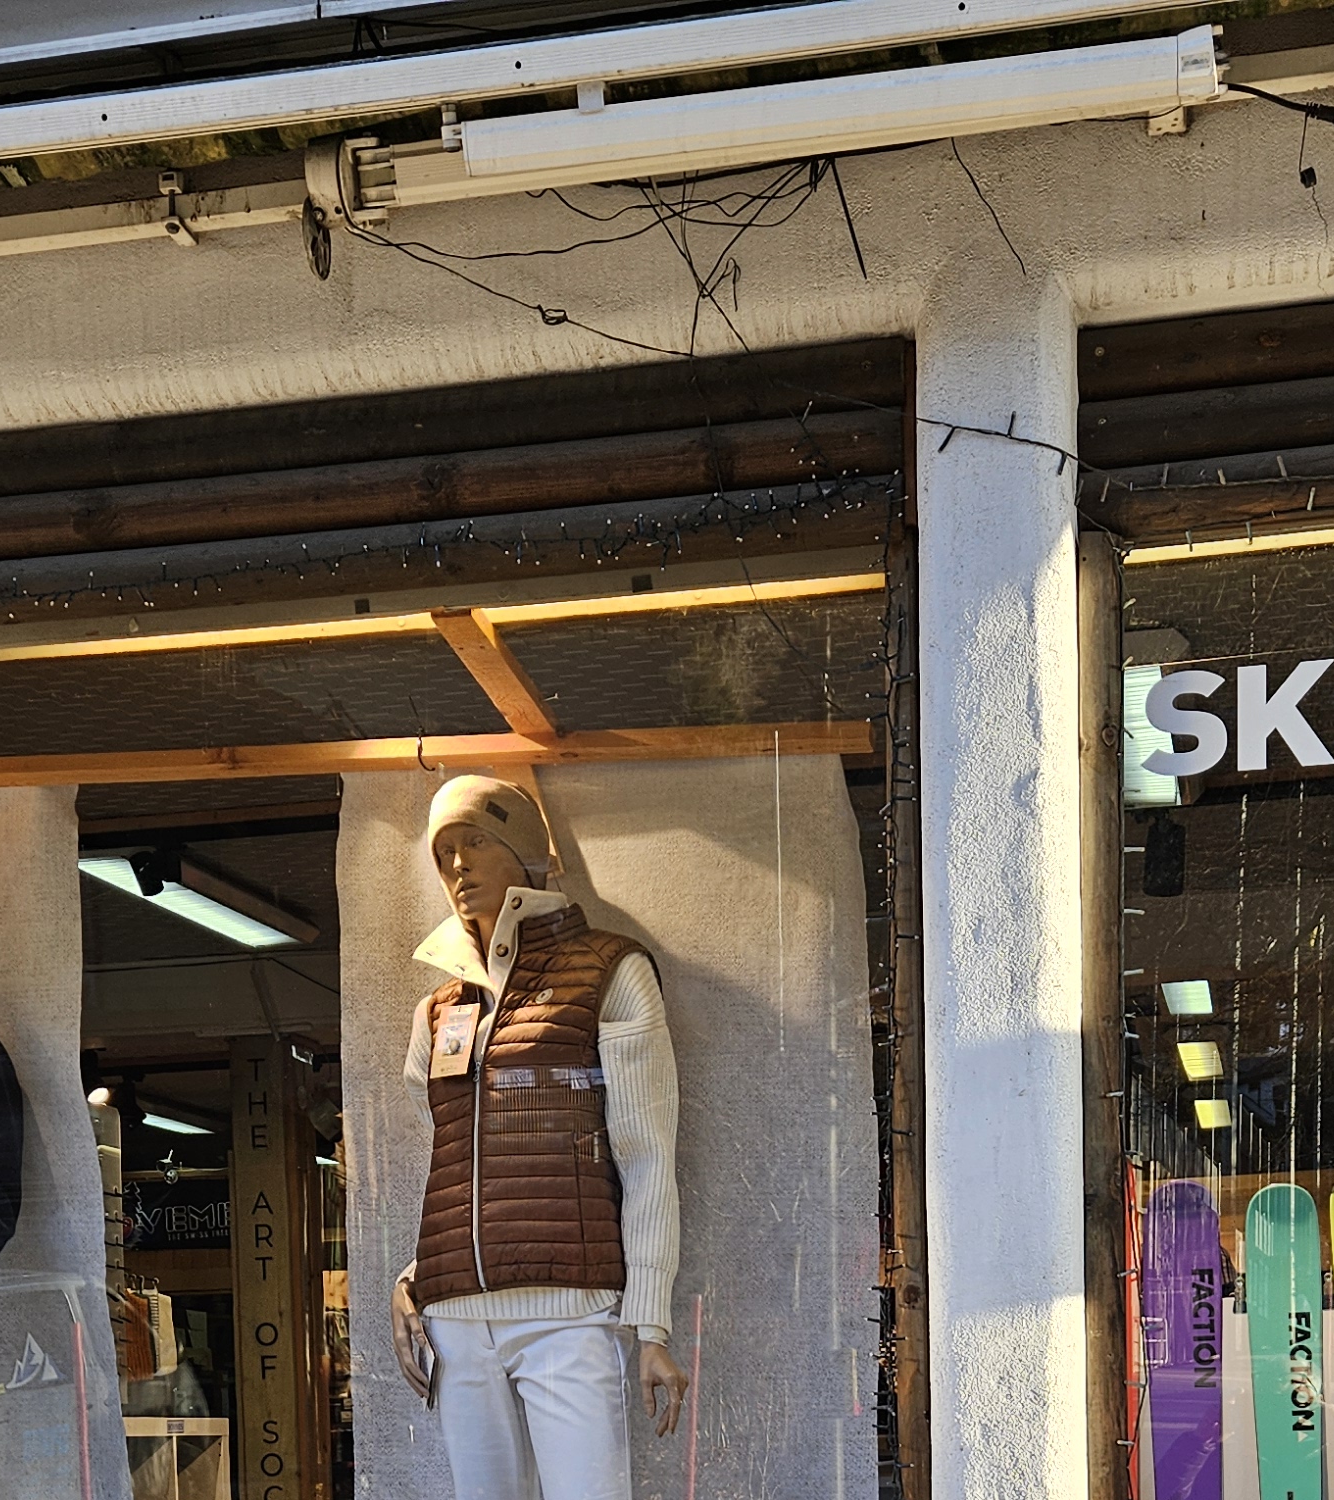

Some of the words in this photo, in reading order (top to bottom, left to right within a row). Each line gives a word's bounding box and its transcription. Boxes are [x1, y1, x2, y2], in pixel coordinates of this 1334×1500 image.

[247, 1058, 268, 1150] THE
[251, 1190, 275, 1281] ART
[254, 1321, 279, 1380] OF
[1192, 1268, 1217, 1388] FACTION
[1289, 1312, 1315, 1431] FACTION
